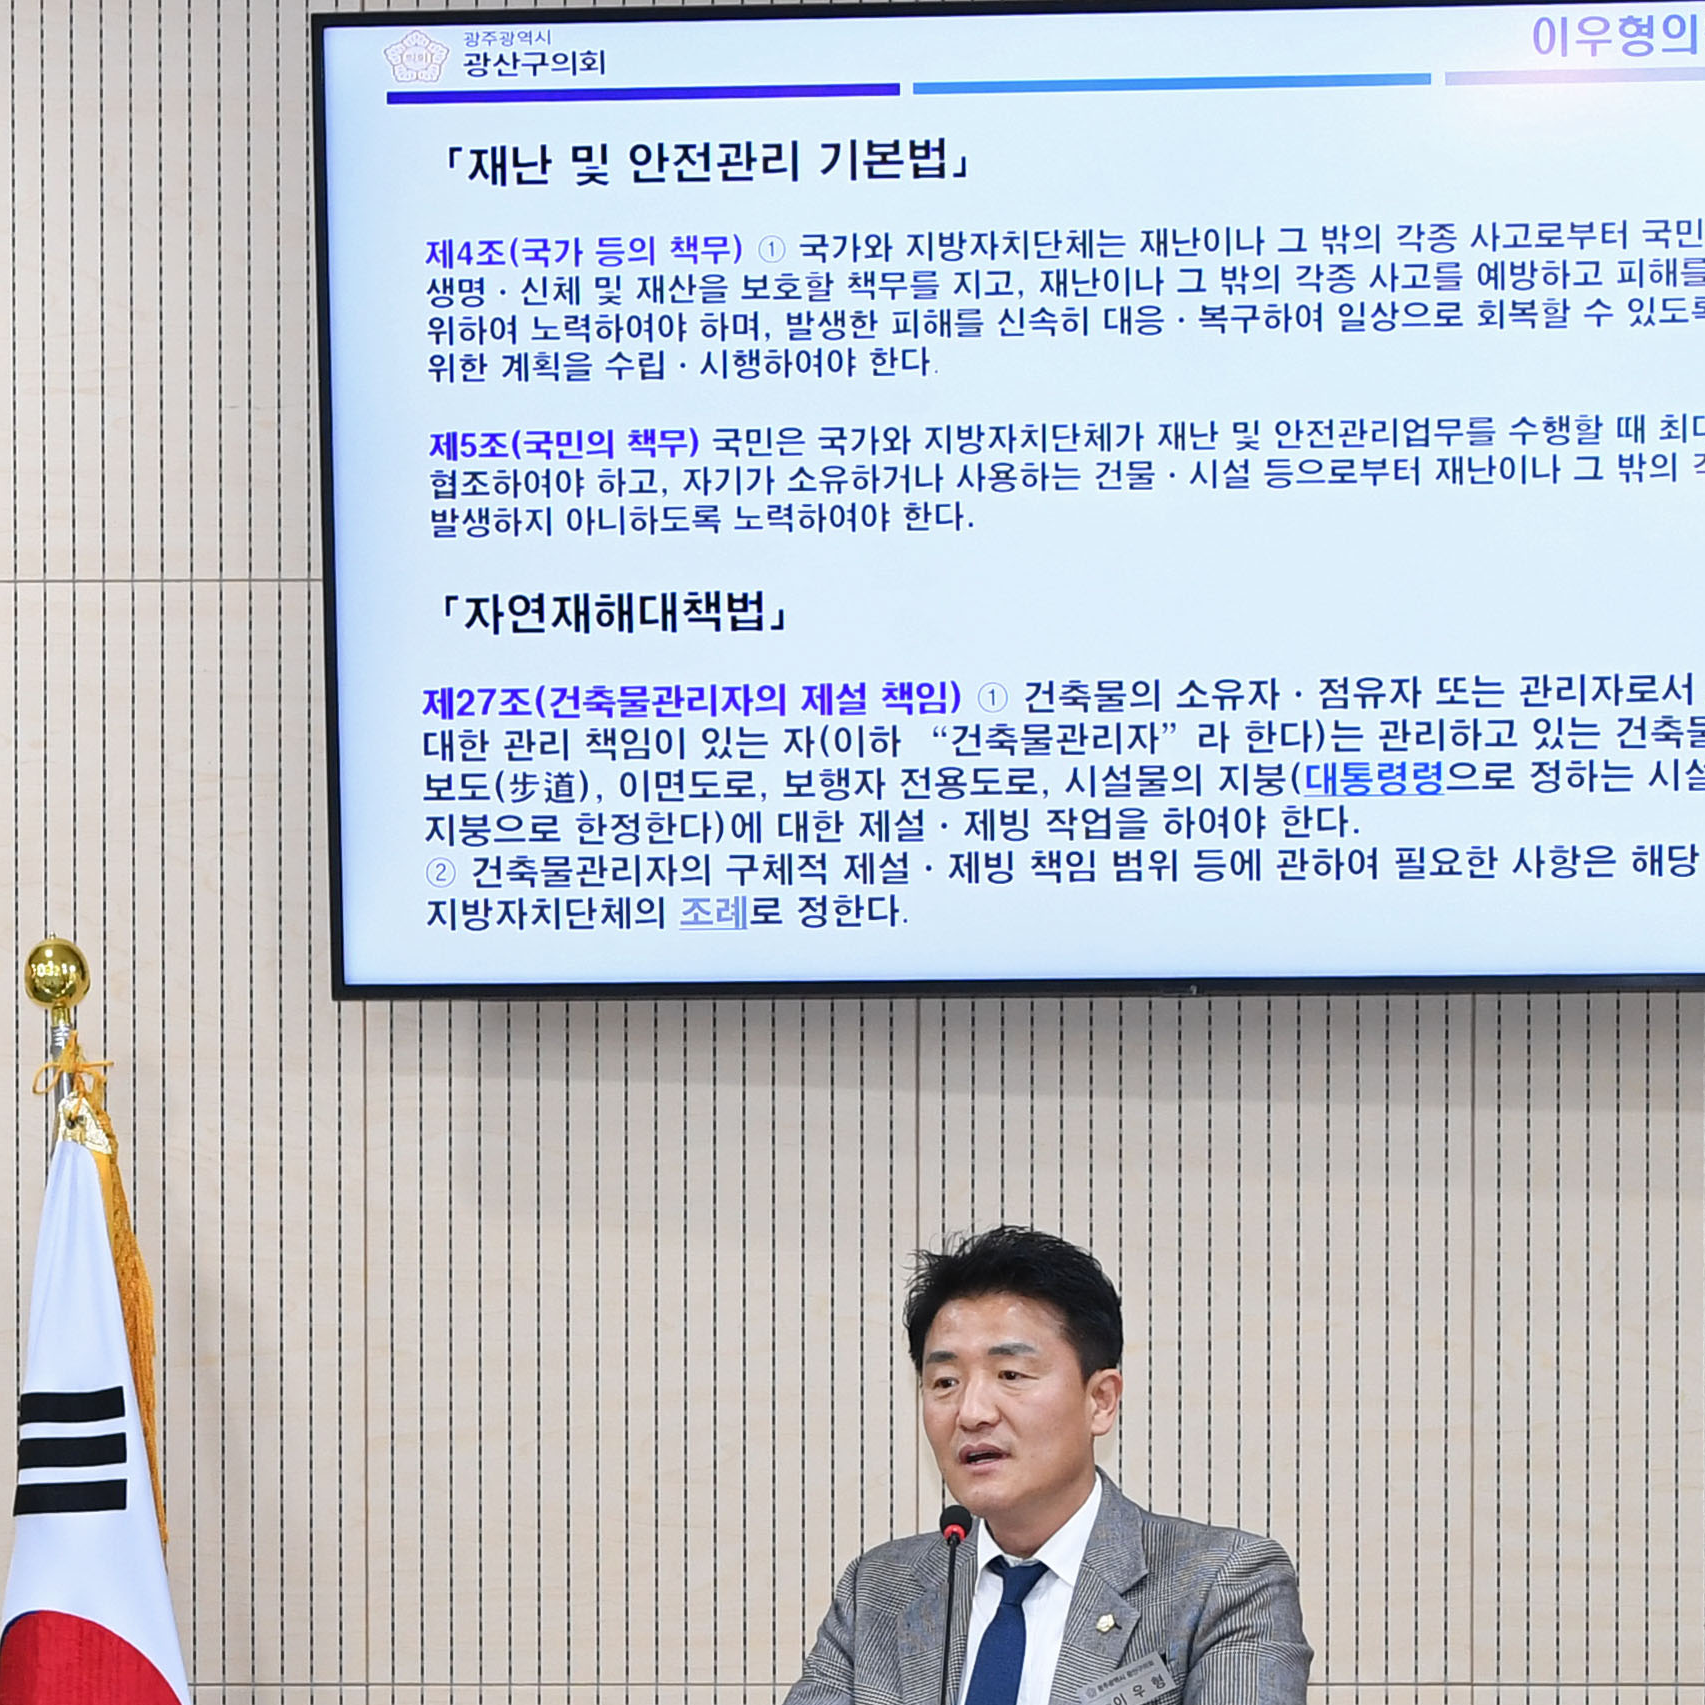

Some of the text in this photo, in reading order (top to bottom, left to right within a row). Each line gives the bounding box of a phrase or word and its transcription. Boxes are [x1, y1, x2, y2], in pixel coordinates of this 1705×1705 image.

[464, 29, 552, 47] 광주광역시
[463, 50, 606, 77] 광산구의회
[572, 142, 610, 187] 및
[629, 139, 799, 184] 안전관리
[425, 236, 583, 269] 제4조(국가
[595, 235, 655, 268] 등의
[670, 232, 742, 266] 책무)
[799, 231, 893, 264] 국가와
[906, 228, 1126, 263] 지방자치단체는
[1140, 225, 1265, 259] 재난이나
[1277, 228, 1308, 253] 그
[1322, 223, 1380, 255] 밖의
[1397, 222, 1457, 255] 각종
[1470, 218, 1627, 252] 사고로부터
[426, 276, 485, 309] 생명
[521, 274, 581, 307] 신체
[595, 274, 622, 307] 및
[636, 273, 728, 305] 재산을
[741, 270, 834, 302] 보호할
[848, 269, 940, 301] 책무를
[953, 268, 1023, 300] 지고,
[1040, 265, 1165, 299] 재난이나
[1177, 267, 1207, 293] 그
[1221, 263, 1279, 297] 밖의
[1296, 262, 1356, 294] 각종
[1369, 261, 1463, 293] 사고를
[1477, 258, 1603, 292] 예방하고
[427, 313, 517, 347] 위하여
[531, 311, 687, 345] 노력하여야
[700, 310, 770, 343] 하며,
[786, 308, 879, 342] 발생한
[892, 307, 984, 340] 피해를
[998, 305, 1089, 338] 신속히
[1104, 304, 1165, 337] 대응
[1198, 301, 1323, 335] 복구하여
[1338, 300, 1463, 333] 일상으로
[1478, 297, 1571, 331] 회복할
[1583, 298, 1614, 329] 수
[428, 351, 488, 383] 위한
[502, 351, 593, 383] 계획을
[605, 349, 664, 382] 수립
[700, 346, 857, 380] 시행하여야
[429, 428, 614, 462] 제5조(국민의
[627, 426, 699, 459] 책무)
[712, 426, 806, 459] 국민은
[818, 424, 911, 457] 국가와
[925, 421, 1145, 456] 지방자치단체가
[1158, 420, 1219, 451] 재난
[1233, 419, 1260, 451] 및
[1275, 416, 1496, 450] 안전관리업무를
[1509, 413, 1603, 447] 수행할
[1617, 413, 1645, 444] 때
[430, 467, 585, 500] 협조하여야
[597, 466, 667, 498] 하고,
[683, 464, 775, 497] 자기가
[787, 461, 944, 495] 소유하거나
[956, 461, 1081, 494] 사용하는
[1096, 459, 1155, 491] 건물
[1190, 457, 1250, 490] 시설
[1264, 455, 1420, 490] 등으로부터
[1436, 452, 1561, 487] 재난이나
[1574, 455, 1604, 481] 그
[1618, 451, 1677, 483] 밖의
[431, 500, 973, 539] 발생하지 아니하도록 노력하여야 한다.
[422, 682, 785, 720] 제27조(건축물관리자의
[801, 681, 866, 717] 제설
[882, 679, 961, 717] 책임)
[1025, 678, 1160, 714] 건축물의
[1176, 677, 1280, 712] 소유자
[1319, 674, 1422, 711] 점유자
[1436, 674, 1505, 708] 또는
[1519, 672, 1693, 708] 관리자로서
[423, 728, 490, 763] 대한
[504, 727, 569, 763] 관리
[586, 726, 685, 761] 책임이
[702, 725, 769, 760] 있는
[784, 723, 902, 759] 자(이하
[1198, 719, 1230, 754] 라
[1245, 717, 1364, 755] 한다)는
[1379, 717, 1518, 753] 관리하고
[1533, 715, 1601, 751] 있는
[620, 768, 766, 804] 이면도로,
[783, 766, 886, 802] 보행자
[900, 765, 1048, 801] 전용도로,
[1065, 763, 1201, 799] 시설물의
[1219, 760, 1515, 798] 지붕(대통령령으로
[1531, 758, 1634, 794] 정하는
[425, 812, 561, 848] 지붕으로
[575, 809, 762, 846] 한정한다)에
[778, 809, 844, 844] 대한
[859, 808, 924, 843] 제설
[964, 807, 1029, 843] 제빙
[1046, 806, 1149, 841] 작업을
[1163, 805, 1266, 841] 하여야
[1281, 804, 1359, 839] 한다.
[473, 852, 710, 889] 건축물관리자의
[726, 851, 827, 887] 구체적
[844, 850, 909, 885] 제설
[948, 850, 1013, 885] 제빙
[1031, 849, 1095, 884] 책임
[1113, 848, 1177, 883] 범위
[1193, 847, 1261, 883] 등에
[1276, 846, 1377, 882] 관하여
[1395, 845, 1498, 880] 필요한
[1512, 844, 1617, 880] 사항은
[1632, 843, 1700, 878] 해당
[427, 893, 908, 932] 지방자치단체의 조례로 정한다.
